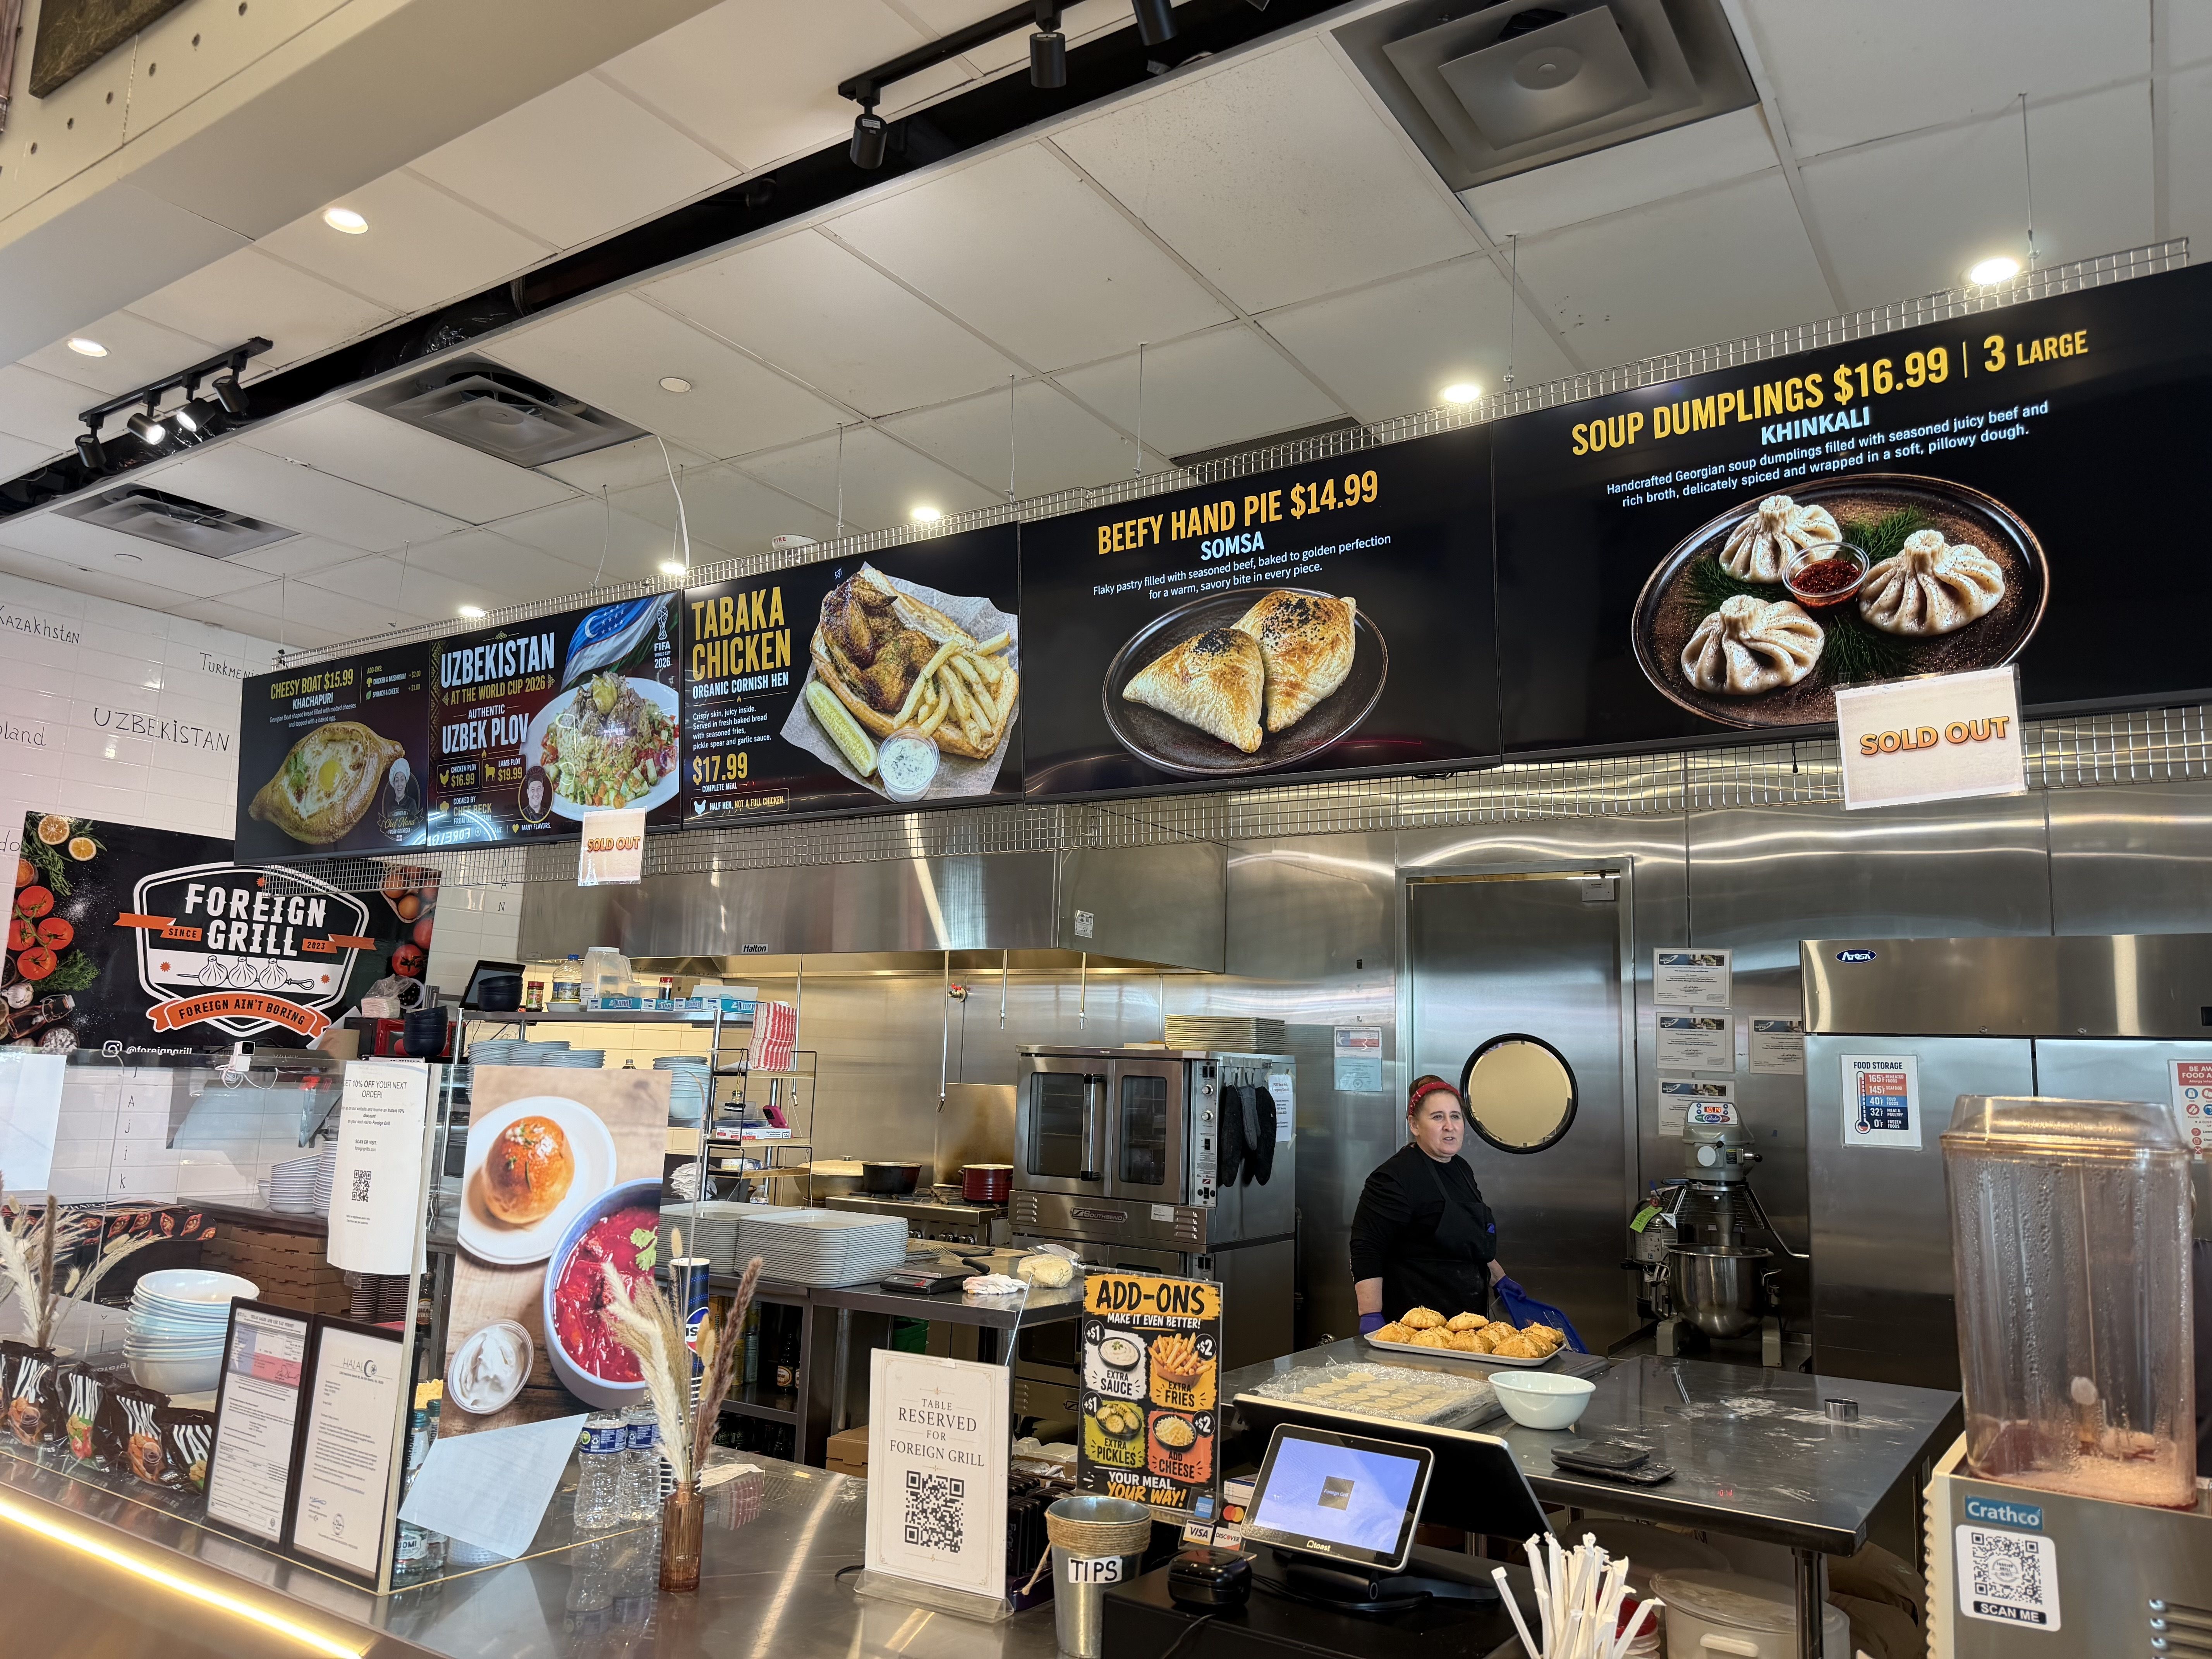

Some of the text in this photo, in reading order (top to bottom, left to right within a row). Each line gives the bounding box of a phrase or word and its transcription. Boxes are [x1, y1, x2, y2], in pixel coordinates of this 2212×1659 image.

[1571, 331, 2088, 456] SOUP DUMPLINGS $16.99 3 LARGE
[1761, 407, 1870, 445] KHINKALI
[1607, 400, 2049, 495] Handcrafted Georgian soup dumplings filled with seasoned juicy beef and
[1098, 470, 1378, 555] BEEFY HAND PIE $14.99
[1200, 531, 1265, 561] SOMSA
[1094, 535, 1391, 595] Flaky pastry filled with seasoned beef, baked to golden perfection
[691, 586, 785, 641] TABAKA
[654, 641, 671, 651] FIFA
[693, 629, 790, 681] CHICKEN
[441, 632, 555, 689] UZBEKISTAN
[654, 657, 671, 668] 2026
[271, 669, 354, 699] CHEESY BOAT $15.99
[451, 675, 545, 705] AT THE WORLD CUP 2026
[693, 672, 788, 699] ORGANIC CORNISH HEN
[293, 692, 333, 710] KHACHAPURI
[468, 704, 505, 720] AUTHENTIC
[693, 712, 709, 721] Crispy
[725, 709, 737, 717] juicy
[738, 705, 756, 714] inside.
[734, 716, 750, 724] baked
[752, 713, 767, 721] bread
[442, 713, 529, 754] UZBEK PLOV
[1860, 716, 2009, 756] SOLD OUT
[498, 767, 522, 782] $19.99
[693, 752, 748, 785] $17.99
[451, 773, 475, 788] $16.99
[702, 784, 724, 792] COMPLETE
[473, 802, 492, 814] BECK
[709, 802, 721, 811] HALF
[722, 801, 733, 809] HEN,
[735, 800, 744, 808] NOT
[750, 798, 762, 806] FULL
[763, 796, 785, 805] CHICKEN.
[385, 818, 397, 829] Chef
[587, 836, 641, 852] SOLD OUT
[185, 883, 327, 927] FOREIGN
[168, 920, 325, 957] SINCE GRILL 2023
[179, 1000, 228, 1019] FOREIGN
[266, 1003, 305, 1026] BORING
[1096, 1280, 1205, 1315] ADD-ONS
[1107, 1312, 1200, 1329] MAKE IT EVEN BETTER!
[1086, 1325, 1100, 1341] +$1
[1197, 1339, 1212, 1356] +$2
[343, 1358, 363, 1371] HALAL
[1107, 1370, 1128, 1381] EXTRA
[1101, 1378, 1132, 1396] SAUCE
[1168, 1381, 1191, 1392] EXTRA
[921, 1398, 952, 1411] TABLE
[1084, 1397, 1097, 1412] +$1
[1165, 1390, 1195, 1407] FRIES
[898, 1407, 977, 1432] RESERVED
[1195, 1416, 1211, 1432] +$2
[926, 1430, 946, 1441] FOR
[1104, 1438, 1127, 1450] EXTRA
[890, 1439, 984, 1467] FOREIGN GRILL
[1097, 1446, 1136, 1465] PICKLES
[1169, 1451, 1182, 1461] ADD
[1159, 1459, 1195, 1479] CHEESE
[1108, 1471, 1176, 1490] YOUR MEAL.
[1107, 1481, 1187, 1507] YOUR WAY!
[1968, 1501, 2039, 1527] Crathco
[1189, 1526, 1209, 1539] VISA
[1215, 1532, 1240, 1542] DISCOVER
[1314, 1542, 1331, 1551] toast
[1070, 1560, 1117, 1582] TIPS
[1980, 1603, 2040, 1623] SCAN ME
